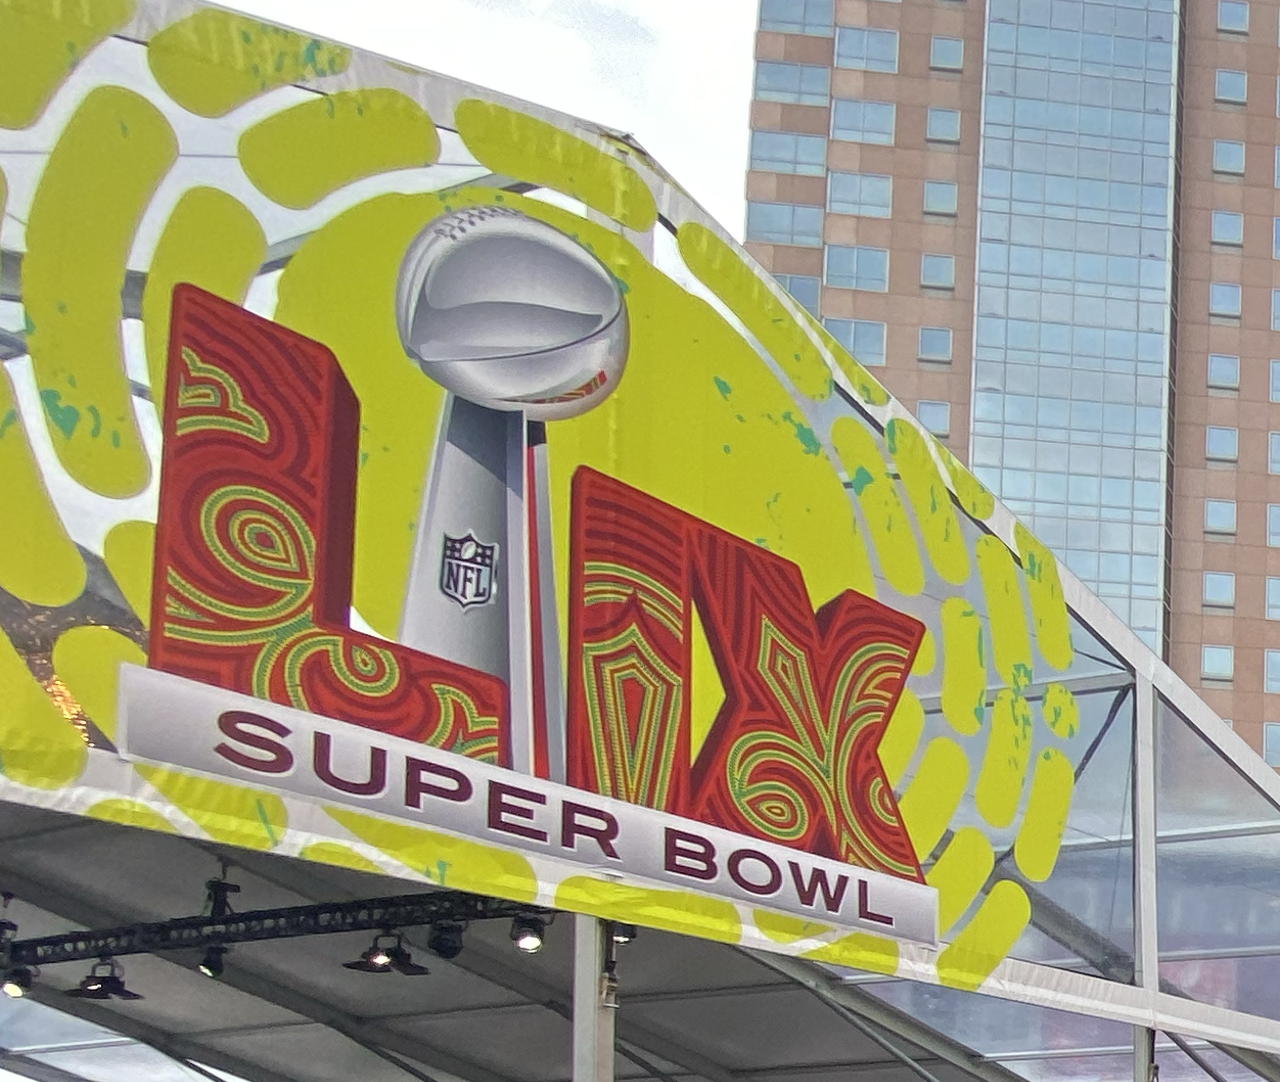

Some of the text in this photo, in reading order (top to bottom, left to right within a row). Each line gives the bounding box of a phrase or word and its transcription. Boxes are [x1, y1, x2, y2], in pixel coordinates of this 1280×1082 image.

[445, 561, 488, 600] NFL
[213, 709, 896, 928] SUPER BOWL
